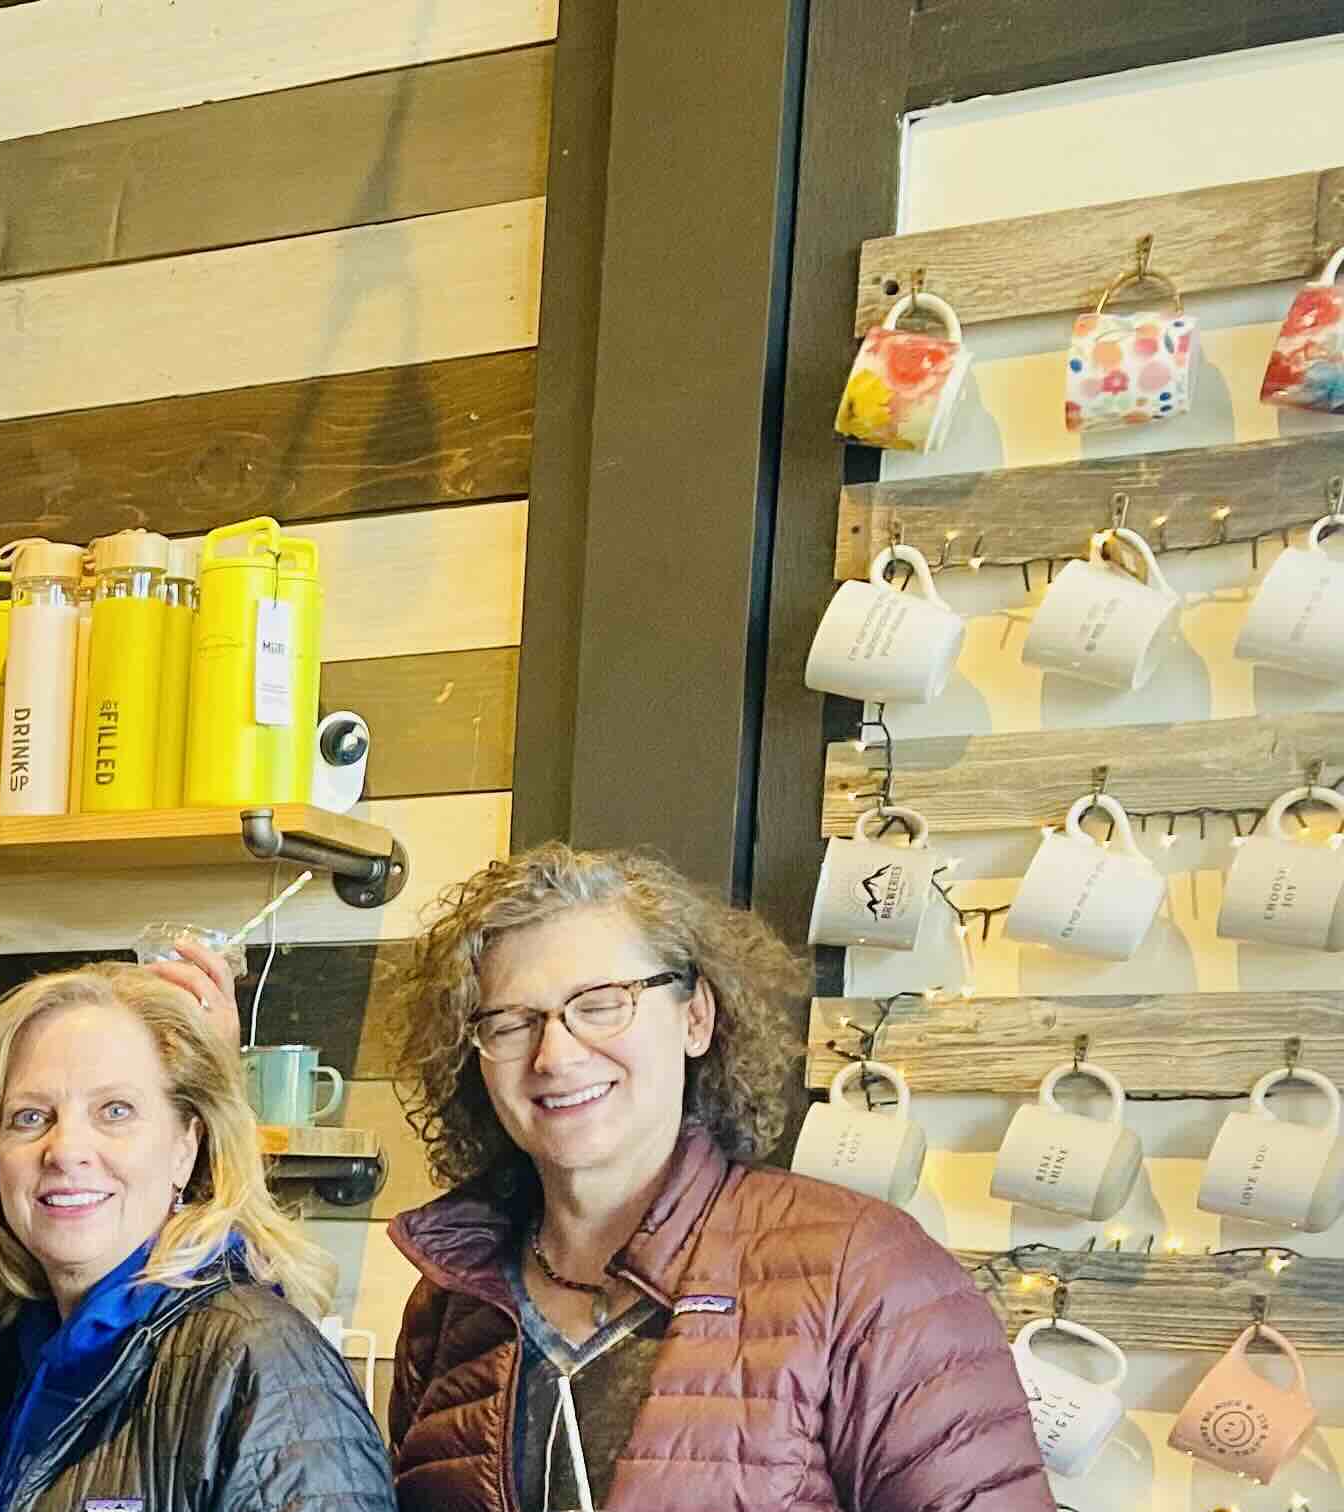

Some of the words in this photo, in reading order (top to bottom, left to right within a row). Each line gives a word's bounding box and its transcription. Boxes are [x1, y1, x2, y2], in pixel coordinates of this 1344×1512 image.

[11, 707, 31, 776] DRINK
[95, 712, 119, 786] FILLED
[9, 775, 29, 793] UP
[880, 864, 903, 921] BREWERIES
